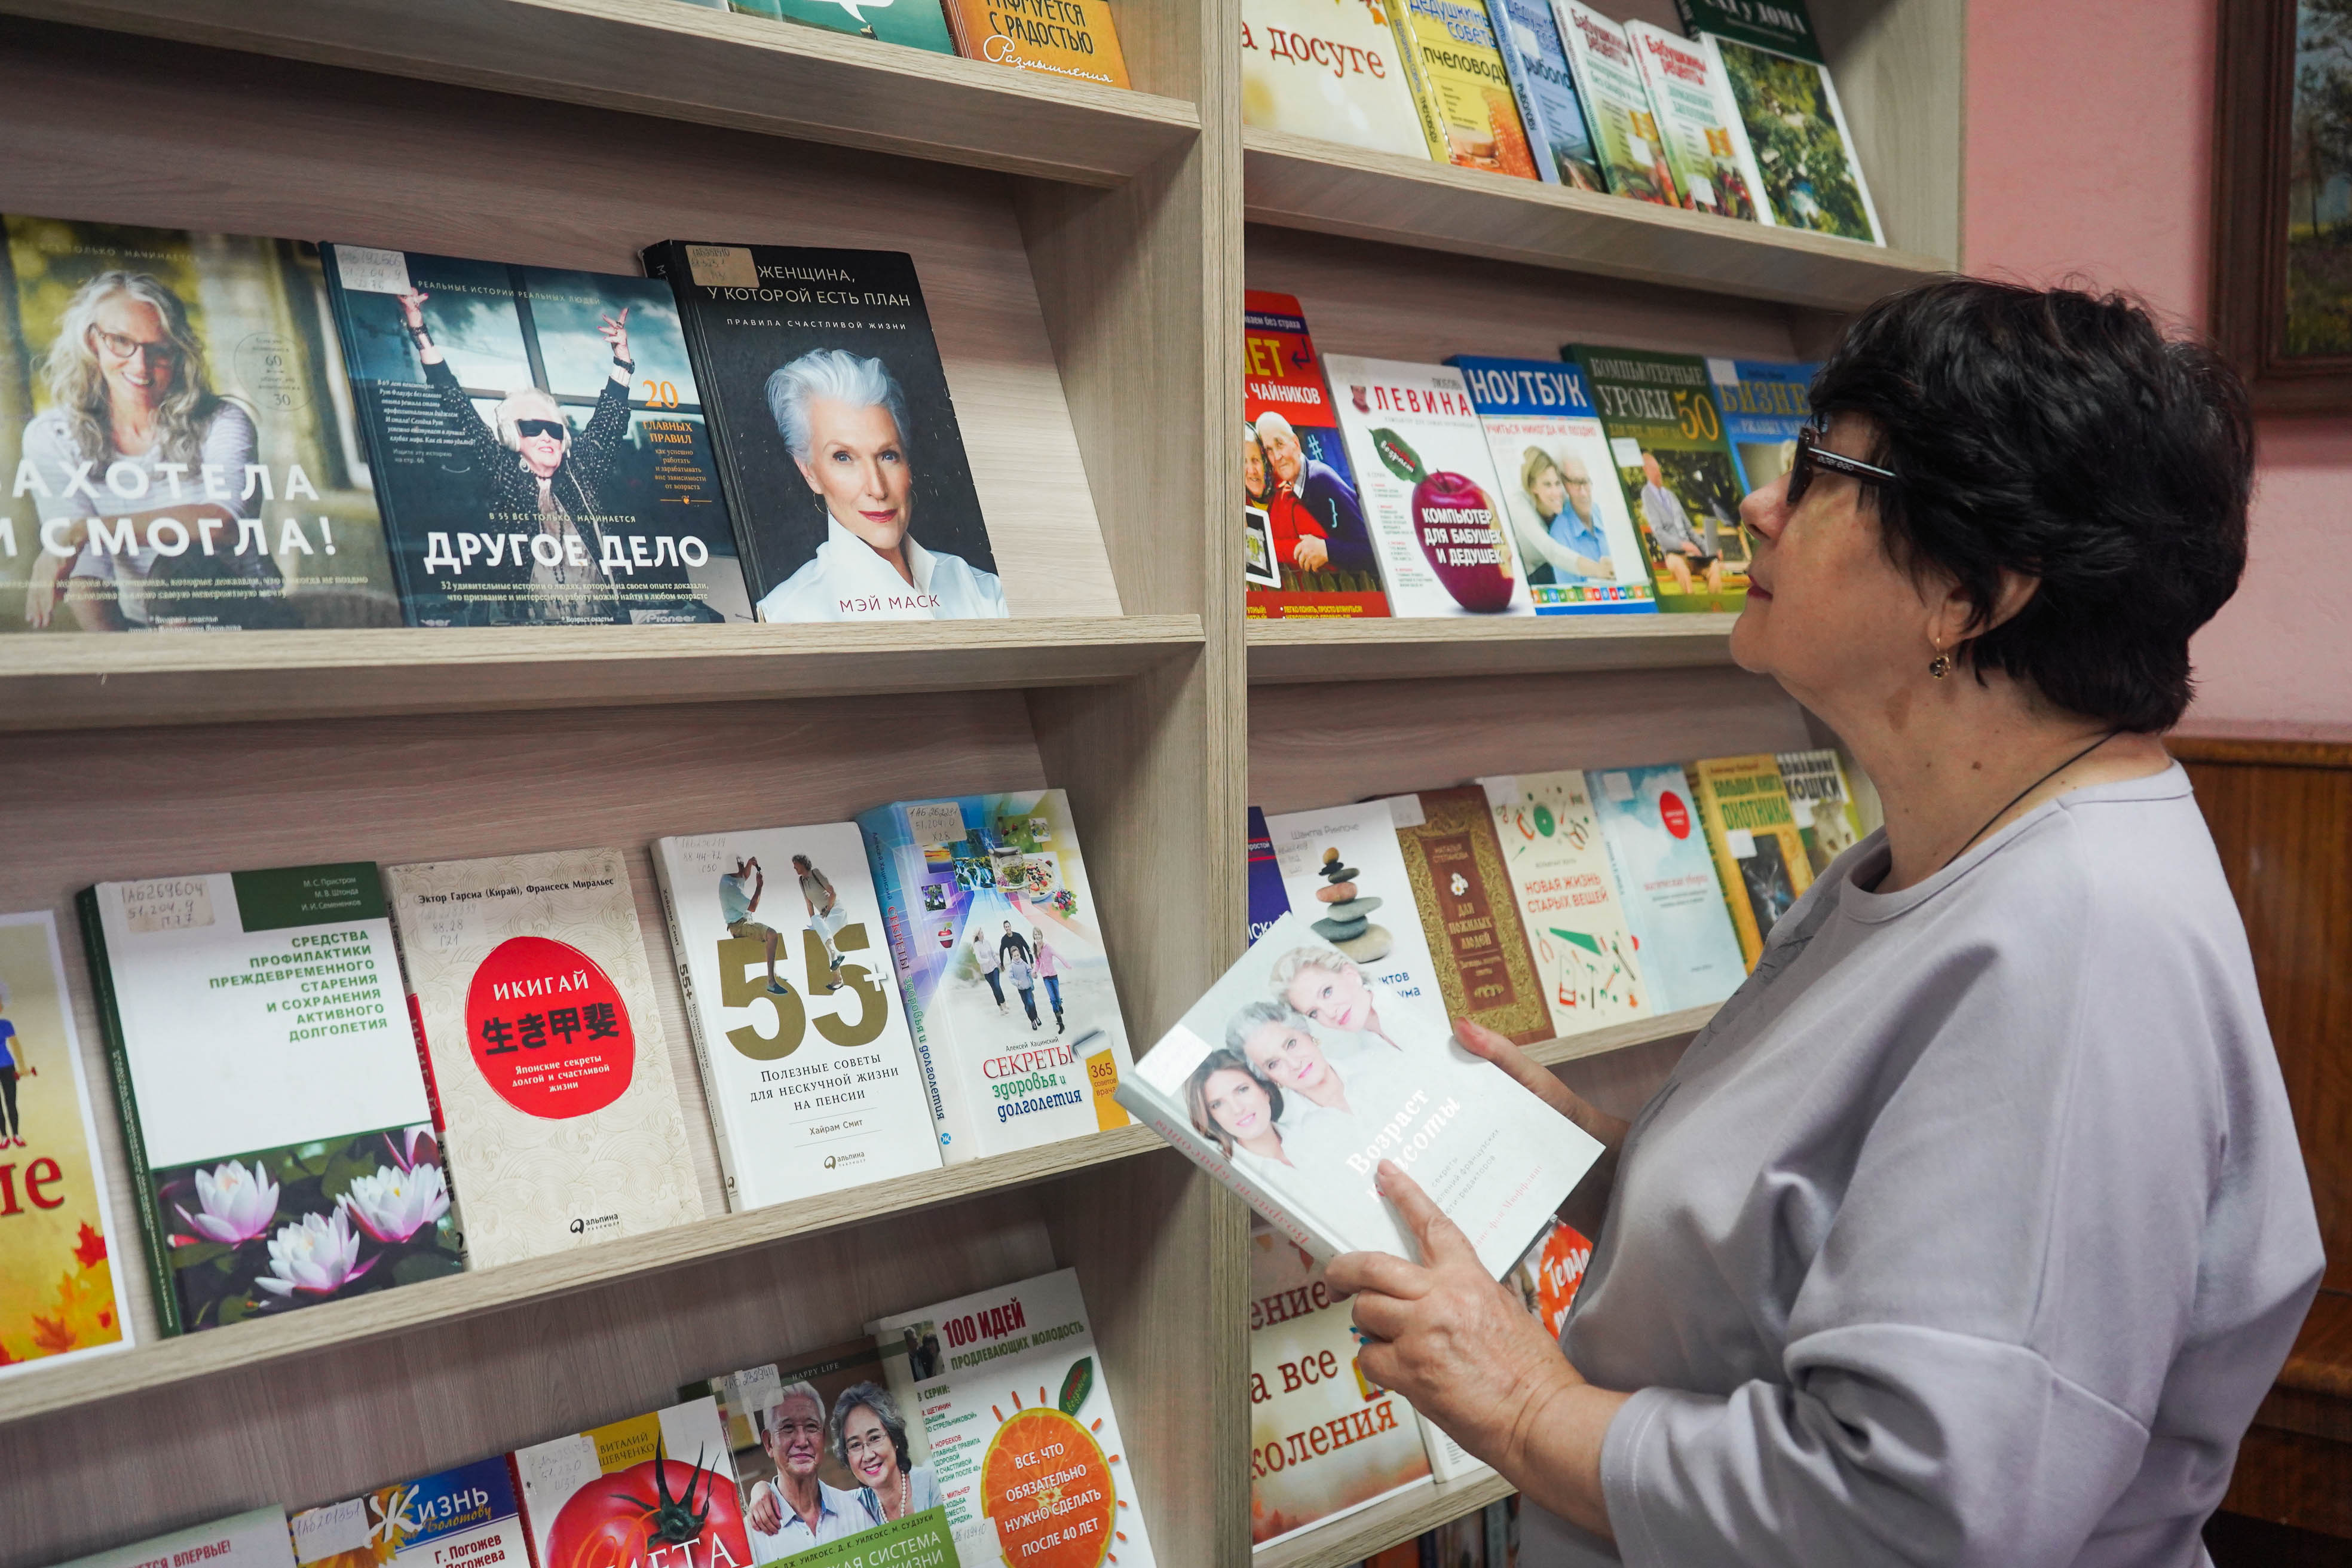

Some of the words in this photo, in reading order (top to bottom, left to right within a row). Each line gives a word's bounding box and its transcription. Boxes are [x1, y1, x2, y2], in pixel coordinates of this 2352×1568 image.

[1004, 14, 1094, 55] РАДОСТЬЮ
[983, 33, 1114, 83] Размышления
[1267, 26, 1386, 79] досуге
[757, 265, 856, 283] ЖЕНЩИНА,
[418, 280, 467, 293] РЕАЛЬНЫЕ
[470, 285, 515, 298] ИСТОРИИ
[517, 290, 565, 302] РЕАЛЬНЫХ
[568, 294, 601, 305] ЛЮДЕЙ
[707, 286, 718, 299] У
[724, 286, 812, 303] КОТОРОЙ
[817, 290, 860, 305] ЕСТЬ
[864, 292, 911, 307] ПЛАН
[726, 318, 781, 327] ПРАВИЛА
[787, 319, 863, 330] СЧАСТЛИВОЙ
[868, 322, 907, 330] ЖИЗНИ
[1590, 357, 1707, 387] КОМПЬЮТЕРНЫЕ
[642, 379, 679, 409] 20
[1250, 380, 1321, 405] ЧАЙНИКОВ
[1468, 369, 1588, 408] НОУТБУК
[1374, 385, 1472, 416] ЛЕВИНА
[1595, 384, 1676, 421] УРОКИ
[1674, 389, 1719, 442] 50
[642, 420, 693, 432] ГЛАВНЫХ
[650, 433, 693, 444] ПРАВИЛ
[12, 458, 320, 501] АХОТЕЛА
[512, 513, 530, 522] ВСЕ
[533, 513, 571, 522] ТОЛЬКО
[577, 514, 636, 523] НАЧИНАЕТСЯ
[1421, 507, 1493, 525] КОМПЬЮТЕР
[39, 515, 336, 558] СМОГЛА!
[1423, 528, 1450, 547] ДЛЯ
[1450, 528, 1504, 545] БАБУШЕК
[423, 531, 589, 575] ДРУГОЕ
[598, 535, 709, 576] ДЕЛО
[1435, 547, 1447, 564] И
[1448, 547, 1503, 567] ДЕДУШЕК
[452, 583, 512, 592] удивительные
[512, 583, 546, 592] истории
[583, 583, 615, 592] которые
[649, 583, 673, 592] опыте
[673, 583, 709, 592] доказали,
[565, 593, 591, 602] работу
[620, 592, 644, 601] найти
[650, 592, 676, 601] любом
[676, 593, 709, 602] возрасте
[840, 595, 881, 614] МЭЙ
[889, 593, 941, 610] МАСК
[320, 877, 356, 886] Пристром
[332, 888, 359, 897] Штонда
[418, 895, 448, 905] Эктор
[450, 891, 482, 902] Гарсиа
[485, 885, 523, 899] (Кирай),
[526, 881, 570, 895] Франсеск
[572, 877, 615, 889] Миральес
[1525, 878, 1562, 895] НОВАЯ
[1562, 872, 1601, 889] ЖИЗНЬ
[318, 899, 362, 909] Семененков
[1527, 894, 1570, 914] СТАРЫХ
[1572, 886, 1609, 906] ВЕЩЕЙ
[291, 930, 369, 948] СРЕДСТВА
[662, 888, 675, 924] Хайрам
[671, 924, 679, 947] Смит
[679, 963, 693, 1000] 55+
[249, 945, 372, 968] ПРОФИЛАКТИКИ
[209, 959, 375, 989] ПРЕЖДЕВРЕМЕННОГО
[300, 974, 378, 993] СТАРЕНИЯ
[492, 969, 589, 1002] ИКИГАЙ
[1379, 972, 1410, 985] ктов
[267, 1003, 277, 1013] И
[281, 988, 381, 1010] СОХРАНЕНИЯ
[716, 922, 889, 1061] 55+
[296, 1003, 385, 1025] АКТИВНОГО
[887, 905, 911, 972] СЕКРЕТЫ
[903, 975, 924, 1034] здоровья
[918, 1045, 945, 1121] долголетия
[289, 1018, 388, 1043] ДОЛГОЛЕТИЯ
[481, 1002, 620, 1056] 生き甲斐
[1005, 1042, 1028, 1052] Алексей
[1029, 1036, 1059, 1048] Хацинский
[515, 1060, 561, 1076] Японские
[564, 1055, 602, 1068] секреты
[761, 1062, 829, 1083] ПОЛЕЗНЫЕ
[834, 1054, 881, 1070] СОВЕТЫ
[983, 1044, 1076, 1080] СЕКРЕТЫ
[1091, 1062, 1113, 1079] 365
[512, 1074, 545, 1088] долгой
[558, 1064, 611, 1080] счастливой
[549, 1081, 579, 1093] жизни
[751, 1089, 774, 1103] ДЛЯ
[779, 1073, 852, 1097] НЕСКУЧНОЙ
[857, 1067, 899, 1083] ЖИЗНИ
[991, 1071, 1058, 1101] здоровья
[1094, 1077, 1117, 1088] советов
[794, 1100, 811, 1111] НА
[816, 1090, 866, 1107] ПЕНСИИ
[1096, 1086, 1116, 1098] врача
[997, 1089, 1083, 1123] долголетия
[809, 1123, 841, 1136] Хайрам
[843, 1119, 863, 1129] Смит
[1345, 1089, 1430, 1177] Возраст
[837, 1151, 865, 1163] альпина
[585, 1212, 619, 1226] альпина
[942, 1315, 978, 1349] 100
[976, 1296, 1027, 1340] ИДЕЙ
[950, 1335, 1030, 1371] ПРОДЛЕВАЮЩИХ
[1031, 1320, 1085, 1347] МОЛОДОСТЬ
[791, 1368, 818, 1380] HAPPY
[820, 1362, 840, 1373] LIFE
[1278, 1349, 1339, 1394] все
[924, 1384, 951, 1400] СЕРИИ:
[926, 1401, 952, 1416] ЩЕТИНИН
[933, 1411, 978, 1432] СТРЕЛЬНИКОВОЙ»
[599, 1432, 649, 1454] ВИТАЛИЙ
[935, 1434, 963, 1448] НОРБЕКОВ
[958, 1437, 981, 1450] ПРАВИЛА
[598, 1443, 656, 1467] ШЕВЧЕНКО
[939, 1457, 973, 1474] СЧАСТЛИВОЙ
[1014, 1451, 1040, 1469] ВСЕ,
[1040, 1443, 1065, 1459] ЧТО
[955, 1466, 973, 1478] ПОСЛЕ
[1006, 1463, 1087, 1502] ОБЯЗАТЕЛЬНО
[947, 1486, 970, 1499] МИЛЬНЕР
[1004, 1506, 1050, 1533] НУЖНО
[1051, 1488, 1102, 1516] СДЕЛАТЬ
[901, 1514, 935, 1531] СУДЗУКИ
[434, 1550, 447, 1564] Г.
[449, 1534, 502, 1560] Погожев
[868, 1530, 942, 1566] СИСТЕМА
[1021, 1532, 1062, 1558] ПОСЛЕ
[1062, 1526, 1077, 1541] 40
[1079, 1517, 1099, 1536] ЛЕТ
[173, 1539, 232, 1568] ВПЕРВЫЕ!
